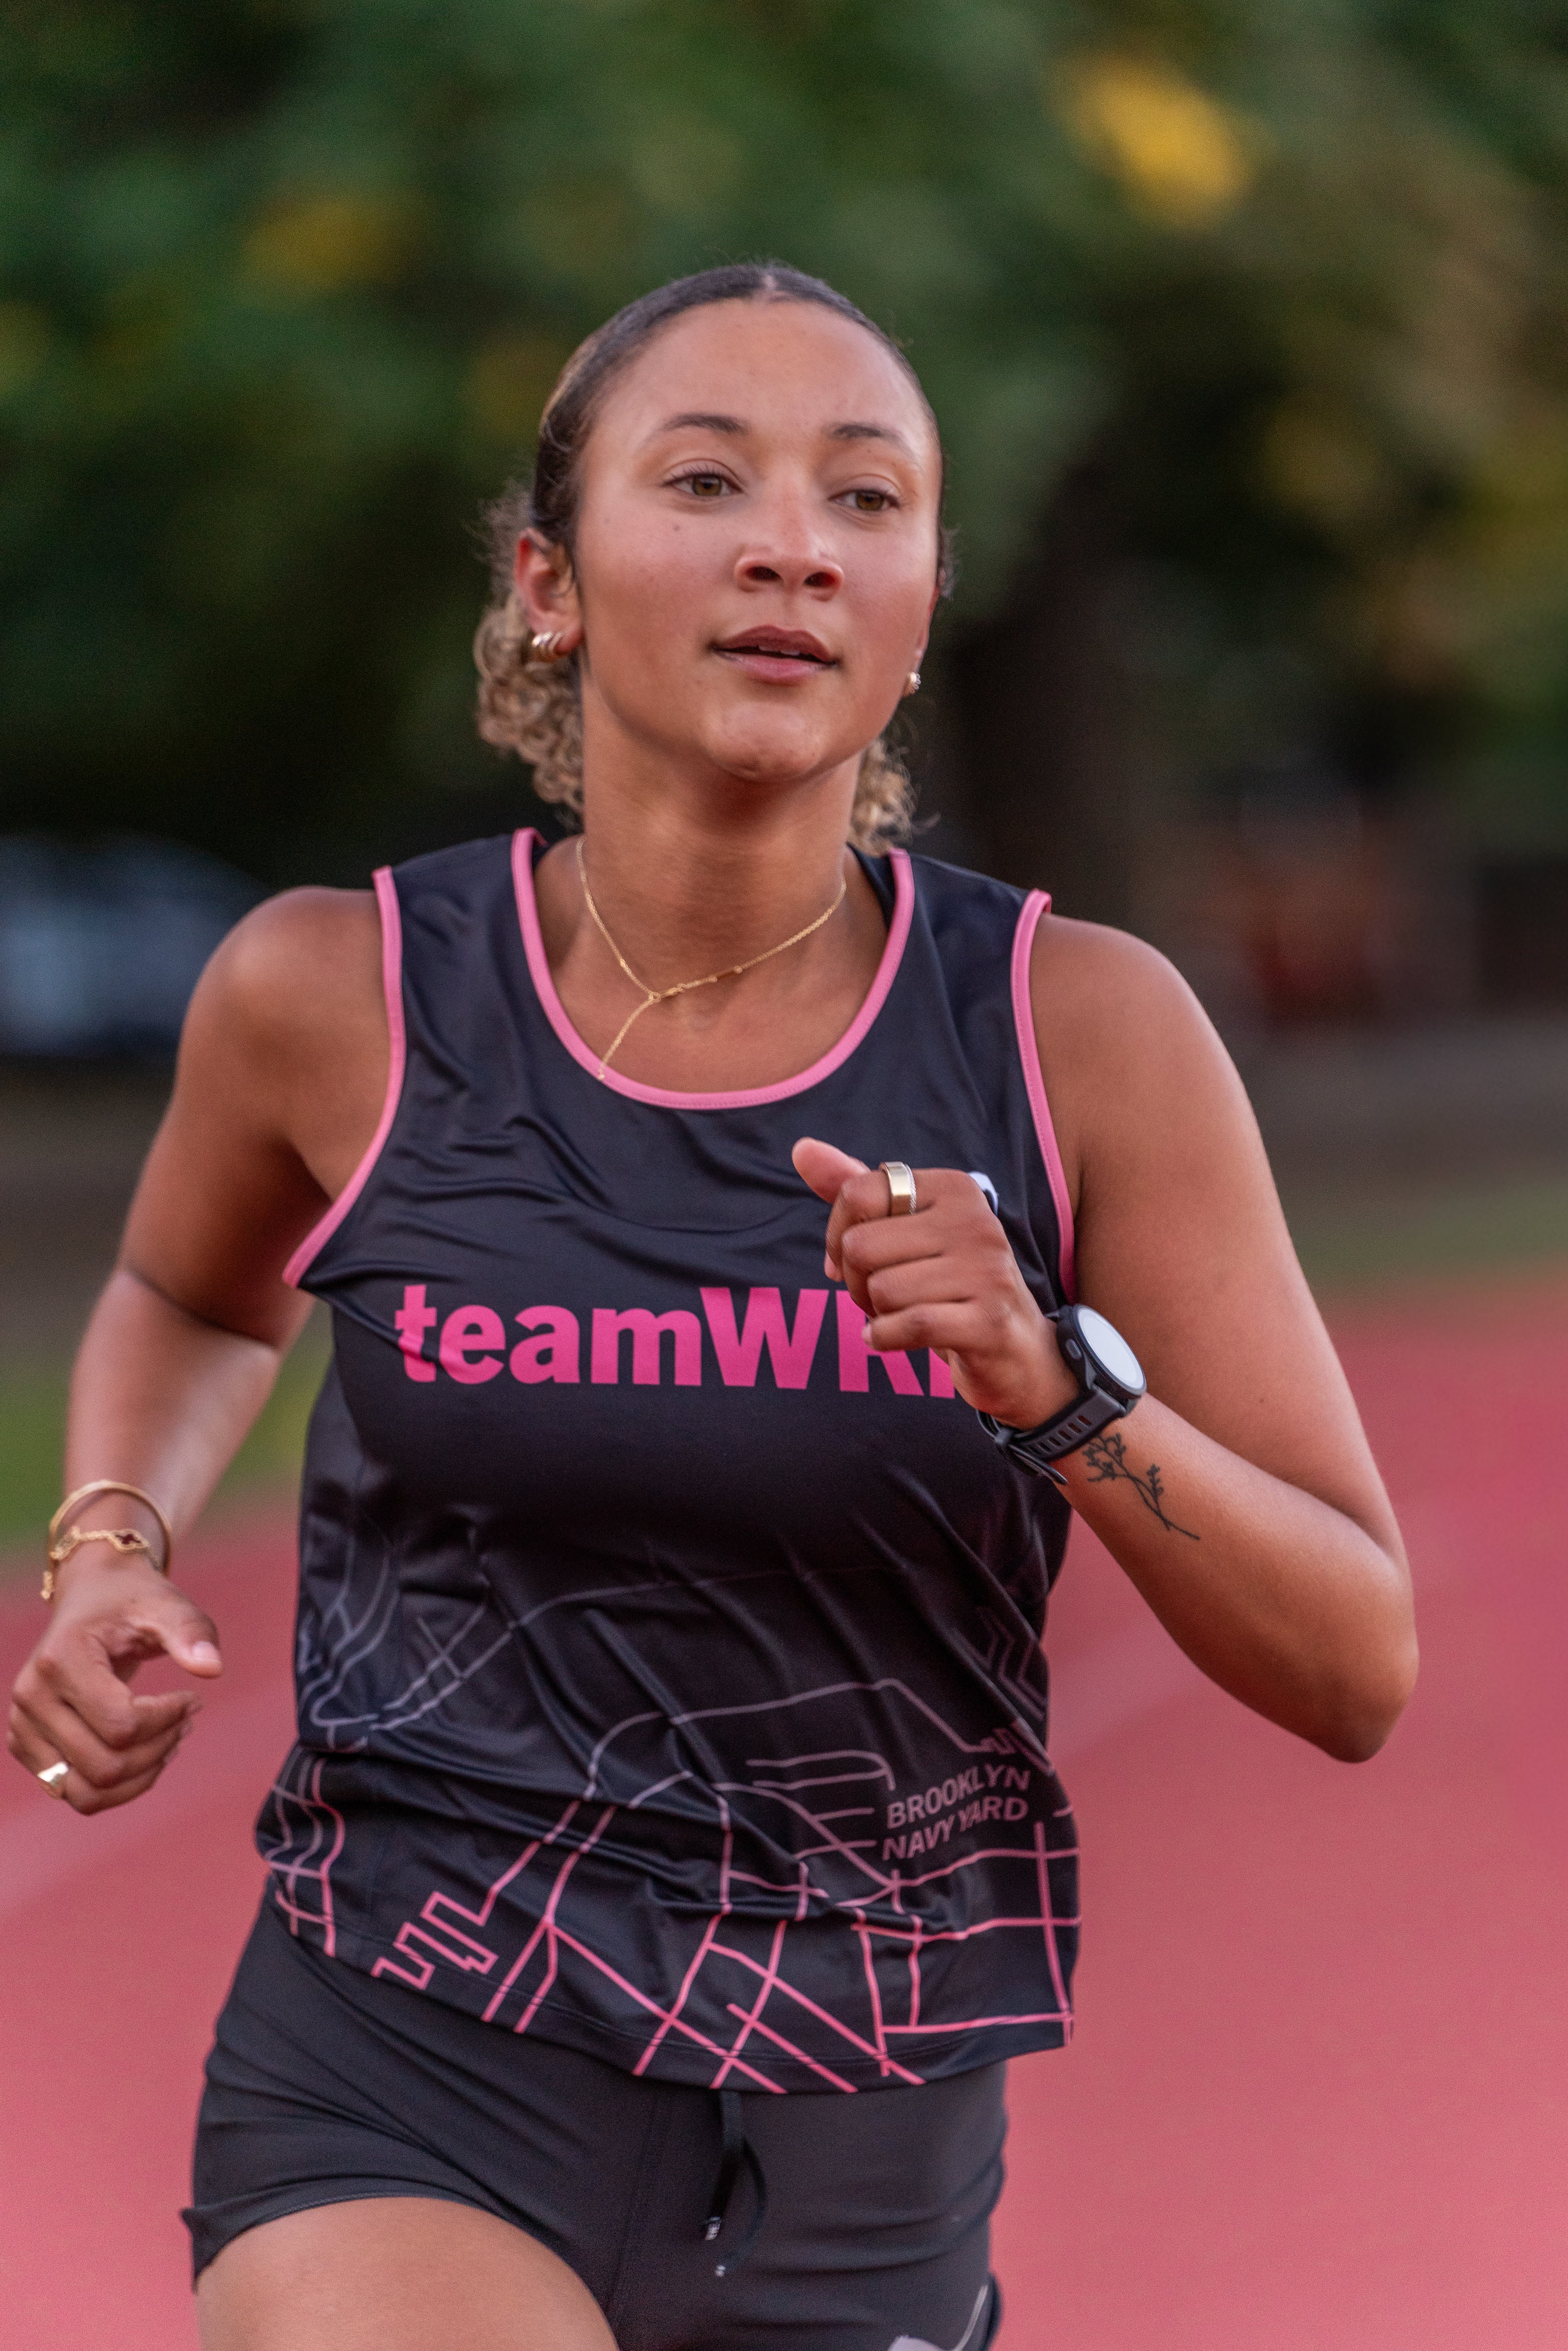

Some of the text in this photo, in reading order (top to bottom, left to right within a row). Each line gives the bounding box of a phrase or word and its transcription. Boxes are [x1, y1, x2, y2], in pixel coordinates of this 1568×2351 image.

[395, 1284, 955, 1399] teamWR
[882, 1796, 1028, 1861] NAVY YARD
[887, 1763, 1030, 1829] BROOKLYN
